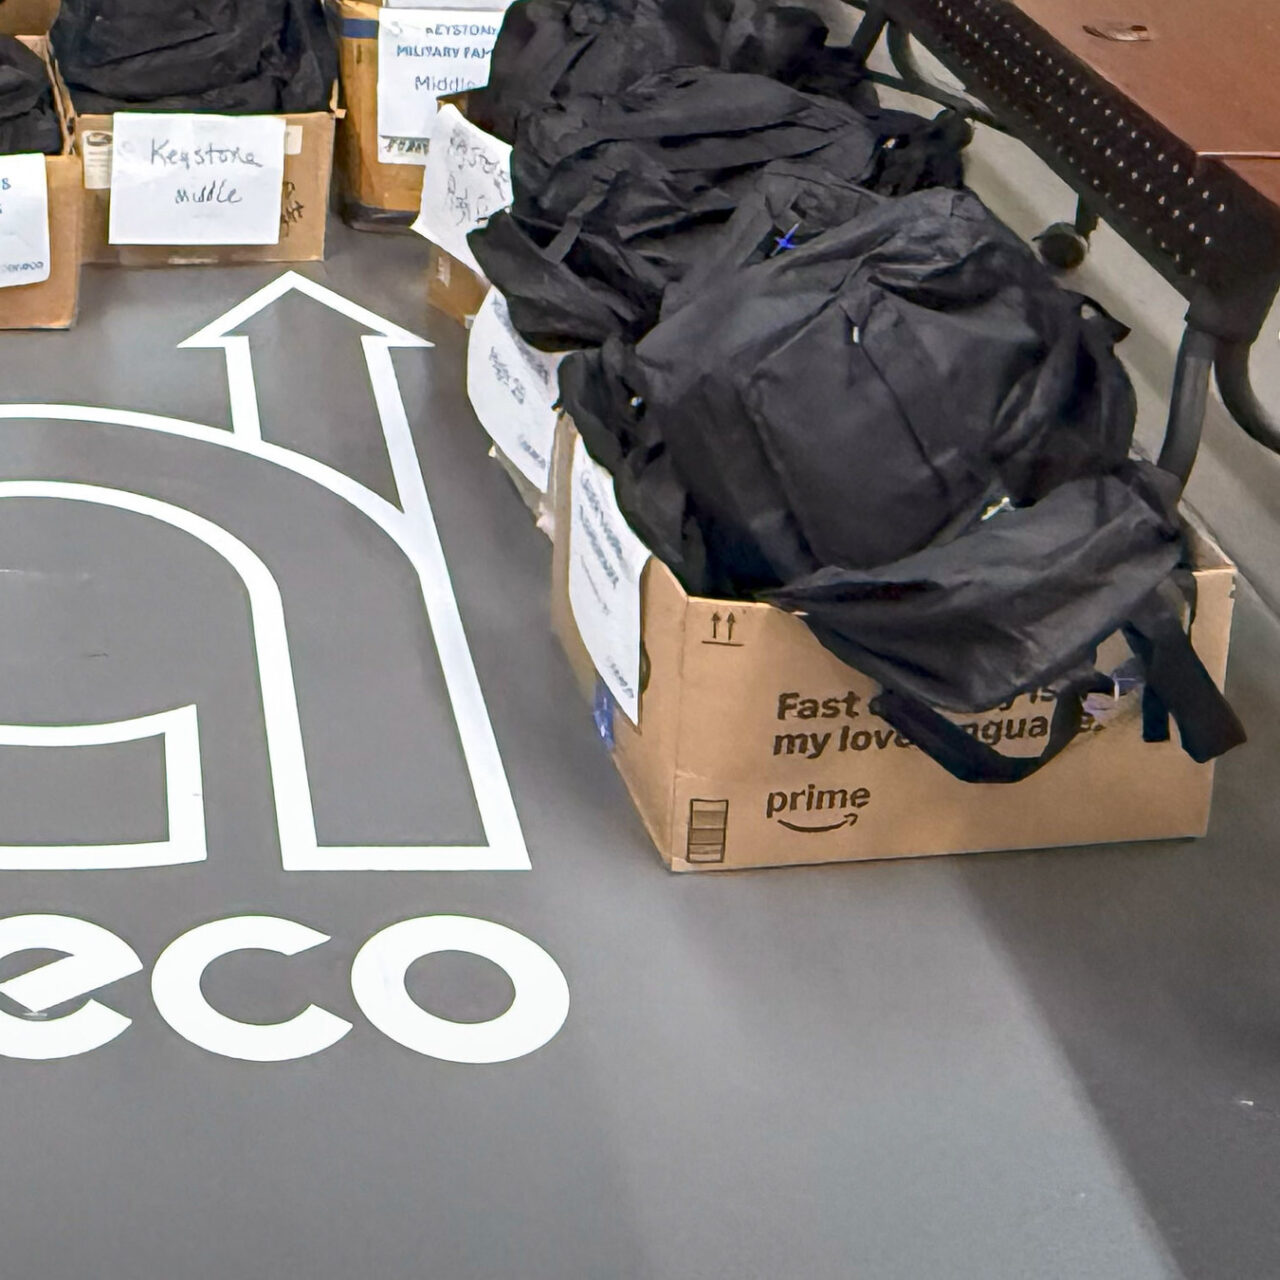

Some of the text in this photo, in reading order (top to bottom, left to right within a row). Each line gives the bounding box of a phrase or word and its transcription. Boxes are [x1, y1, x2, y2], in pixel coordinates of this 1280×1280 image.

[777, 691, 861, 720] Fast
[773, 729, 832, 759] my
[766, 784, 870, 818] prime
